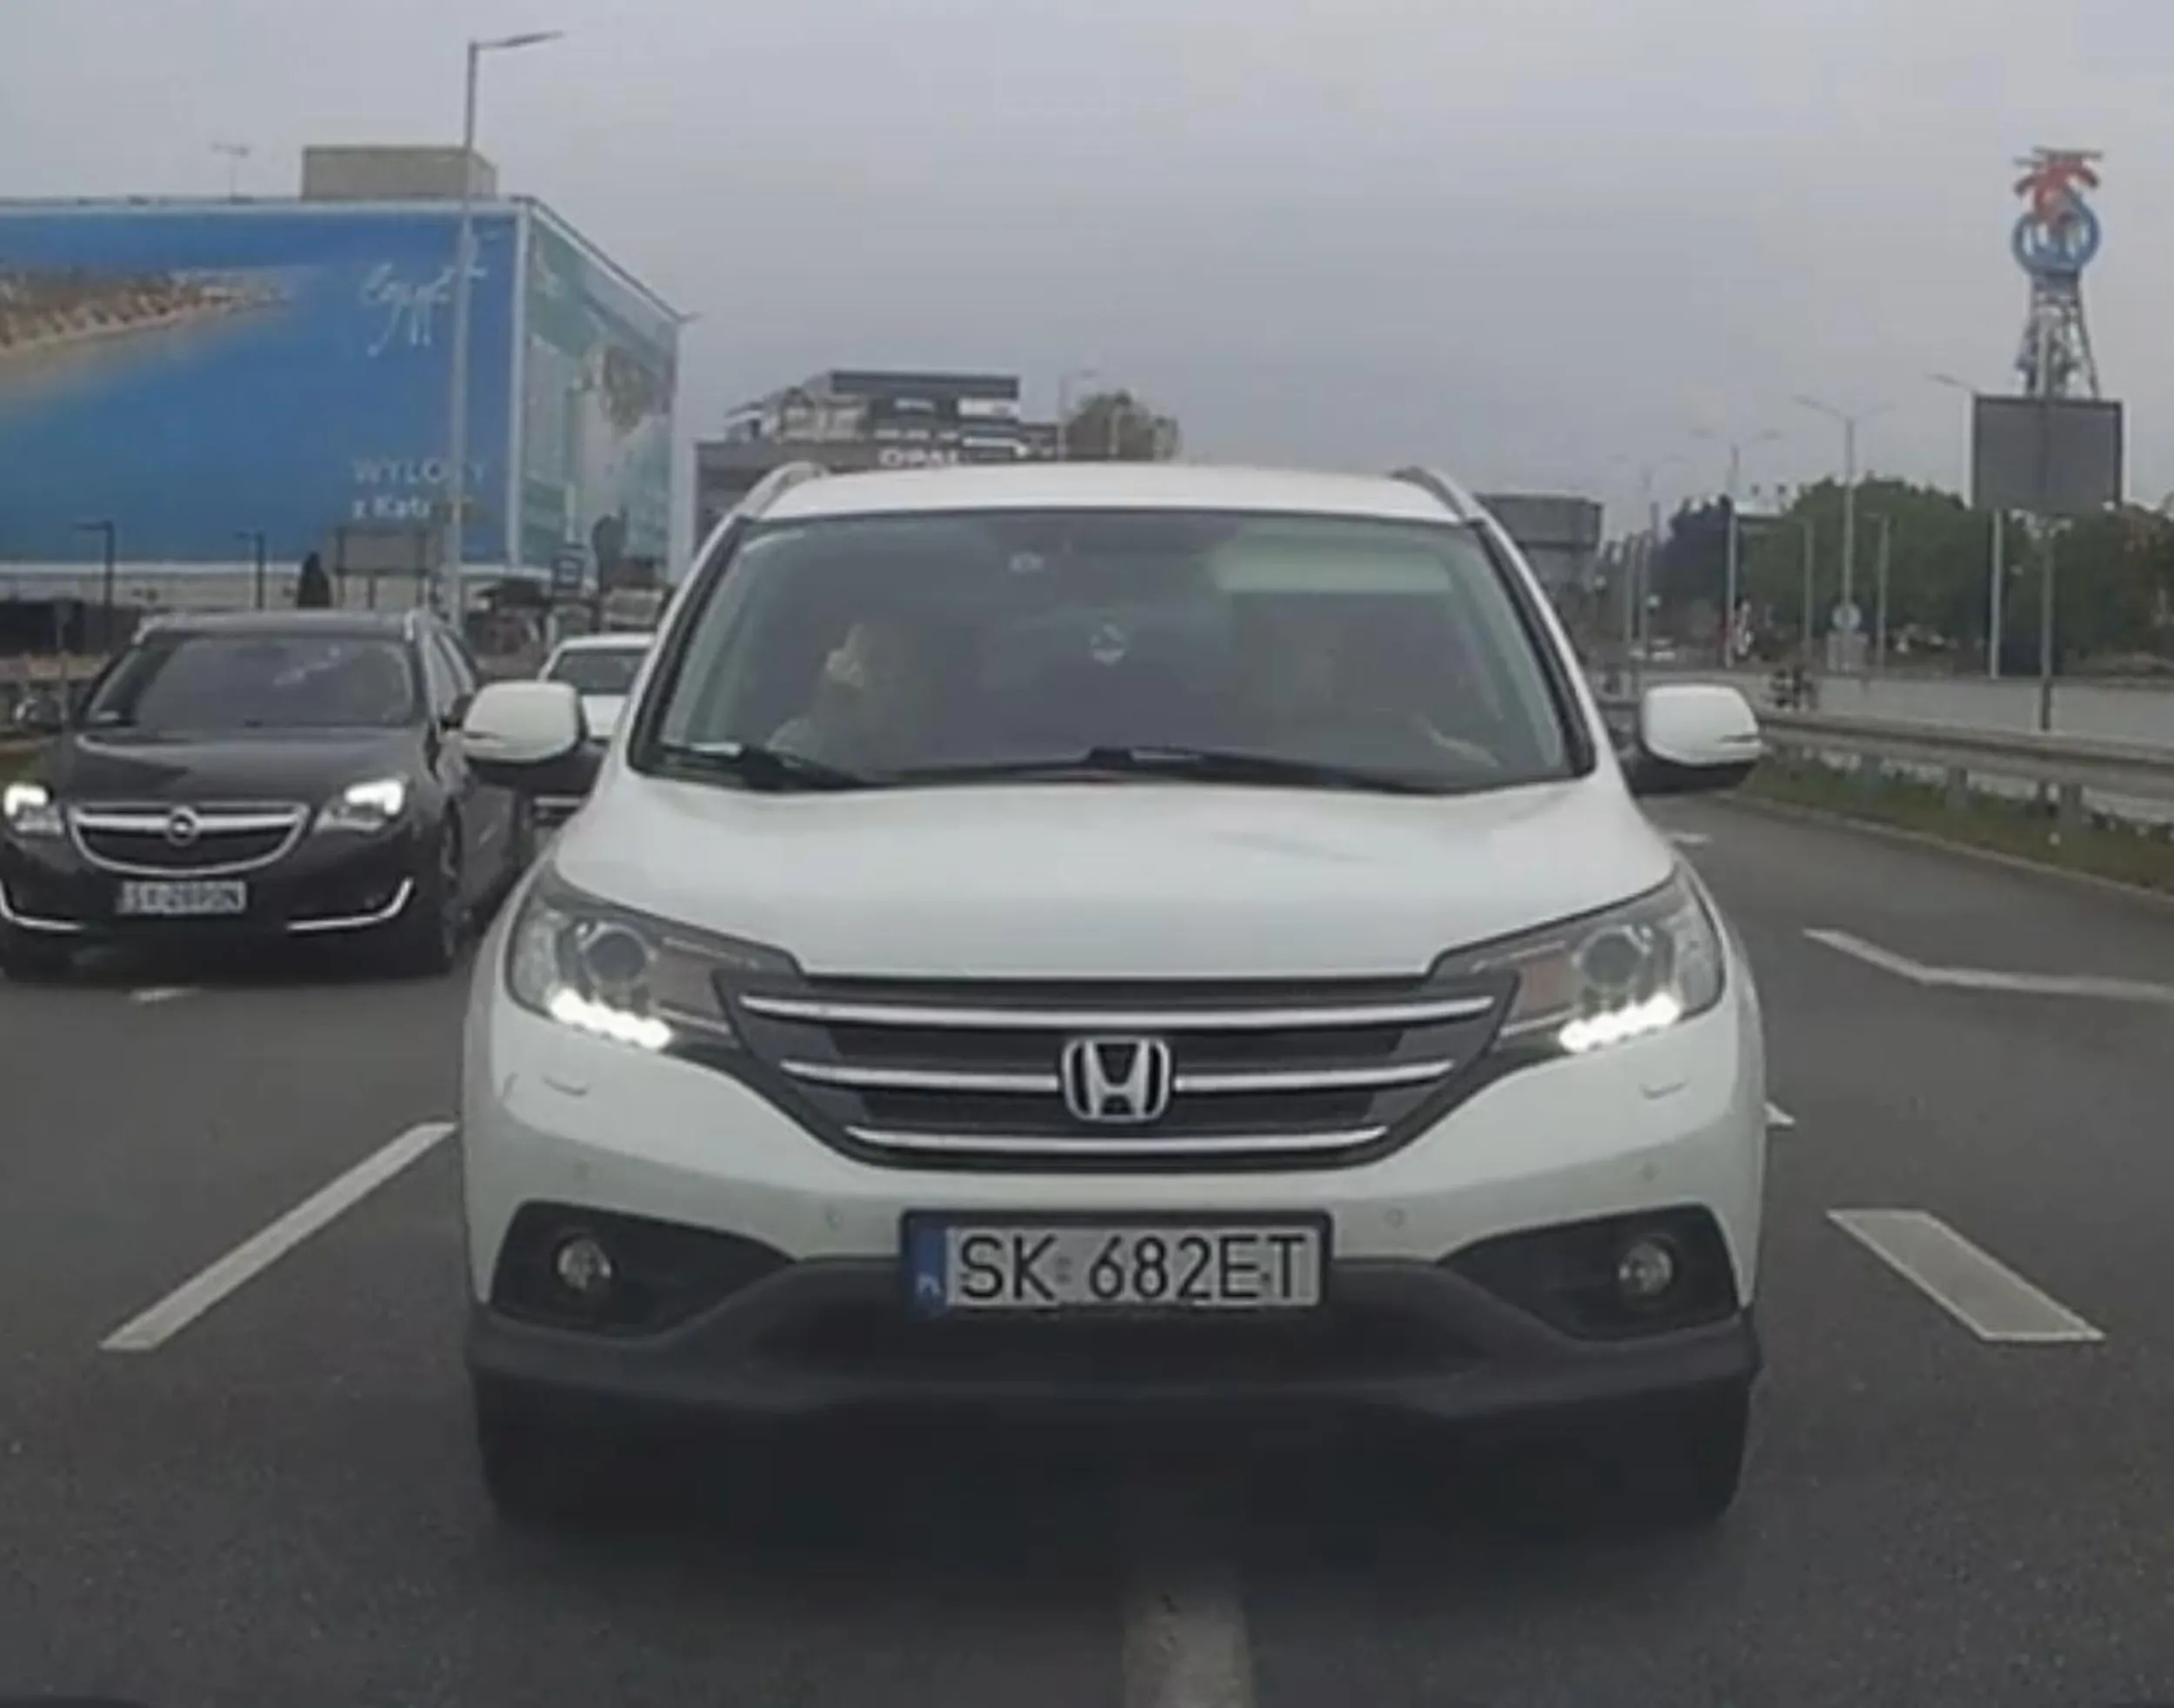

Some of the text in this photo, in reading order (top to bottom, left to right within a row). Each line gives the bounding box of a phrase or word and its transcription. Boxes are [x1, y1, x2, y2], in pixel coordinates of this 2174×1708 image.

[350, 457, 486, 485] WYLOY
[961, 1234, 1305, 1301] SK 682ET
